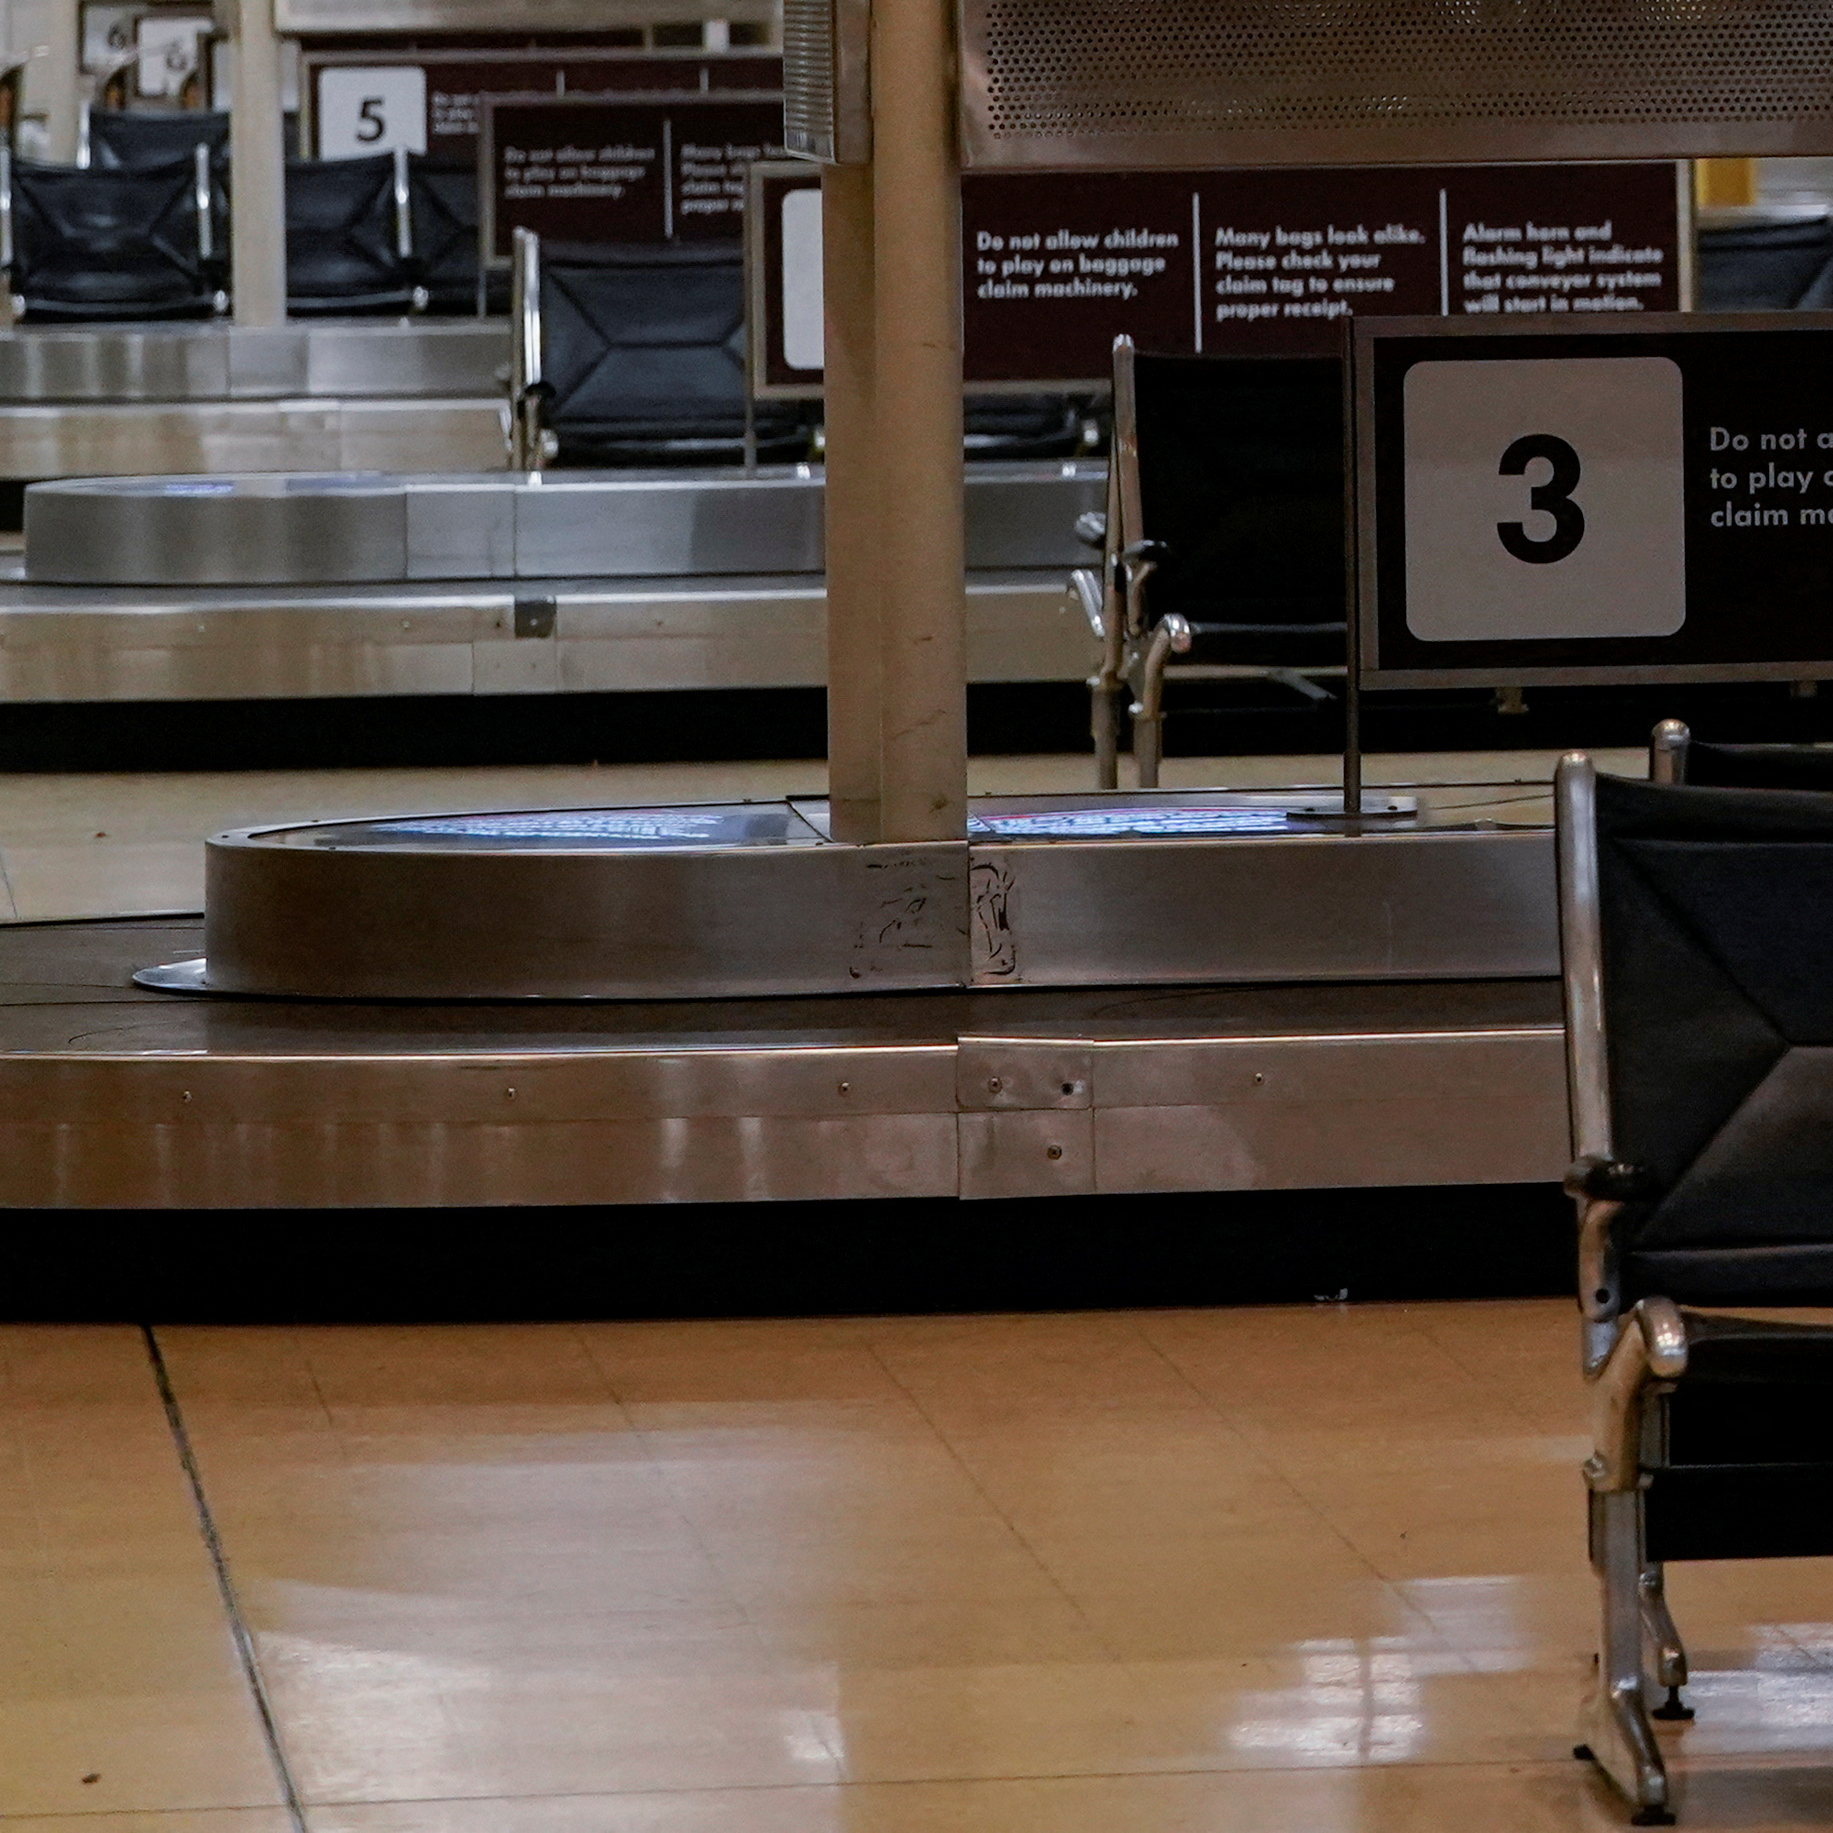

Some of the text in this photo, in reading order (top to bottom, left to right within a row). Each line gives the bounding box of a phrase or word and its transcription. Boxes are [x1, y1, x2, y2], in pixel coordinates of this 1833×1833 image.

[356, 98, 386, 143] 5
[977, 228, 1179, 251] Do not allow children
[1214, 223, 1426, 250] Many bags look alike.
[1462, 219, 1613, 243] Alarm horn and
[977, 252, 1166, 280] to play on baggage
[1215, 246, 1382, 272] Please check your
[1462, 243, 1664, 269] flashing light indicate
[977, 274, 1139, 301] claim machinery.
[1215, 274, 1395, 298] claim tag to ensure
[1463, 270, 1662, 293] that conveyor system
[1216, 297, 1354, 323] proper receipt.
[1463, 292, 1644, 314] will start in motion.
[1709, 426, 1750, 452] Do
[1760, 428, 1808, 450] not
[1709, 468, 1738, 490] to
[1749, 462, 1814, 494] play
[1496, 433, 1586, 565] 3
[1710, 500, 1789, 528] claim
